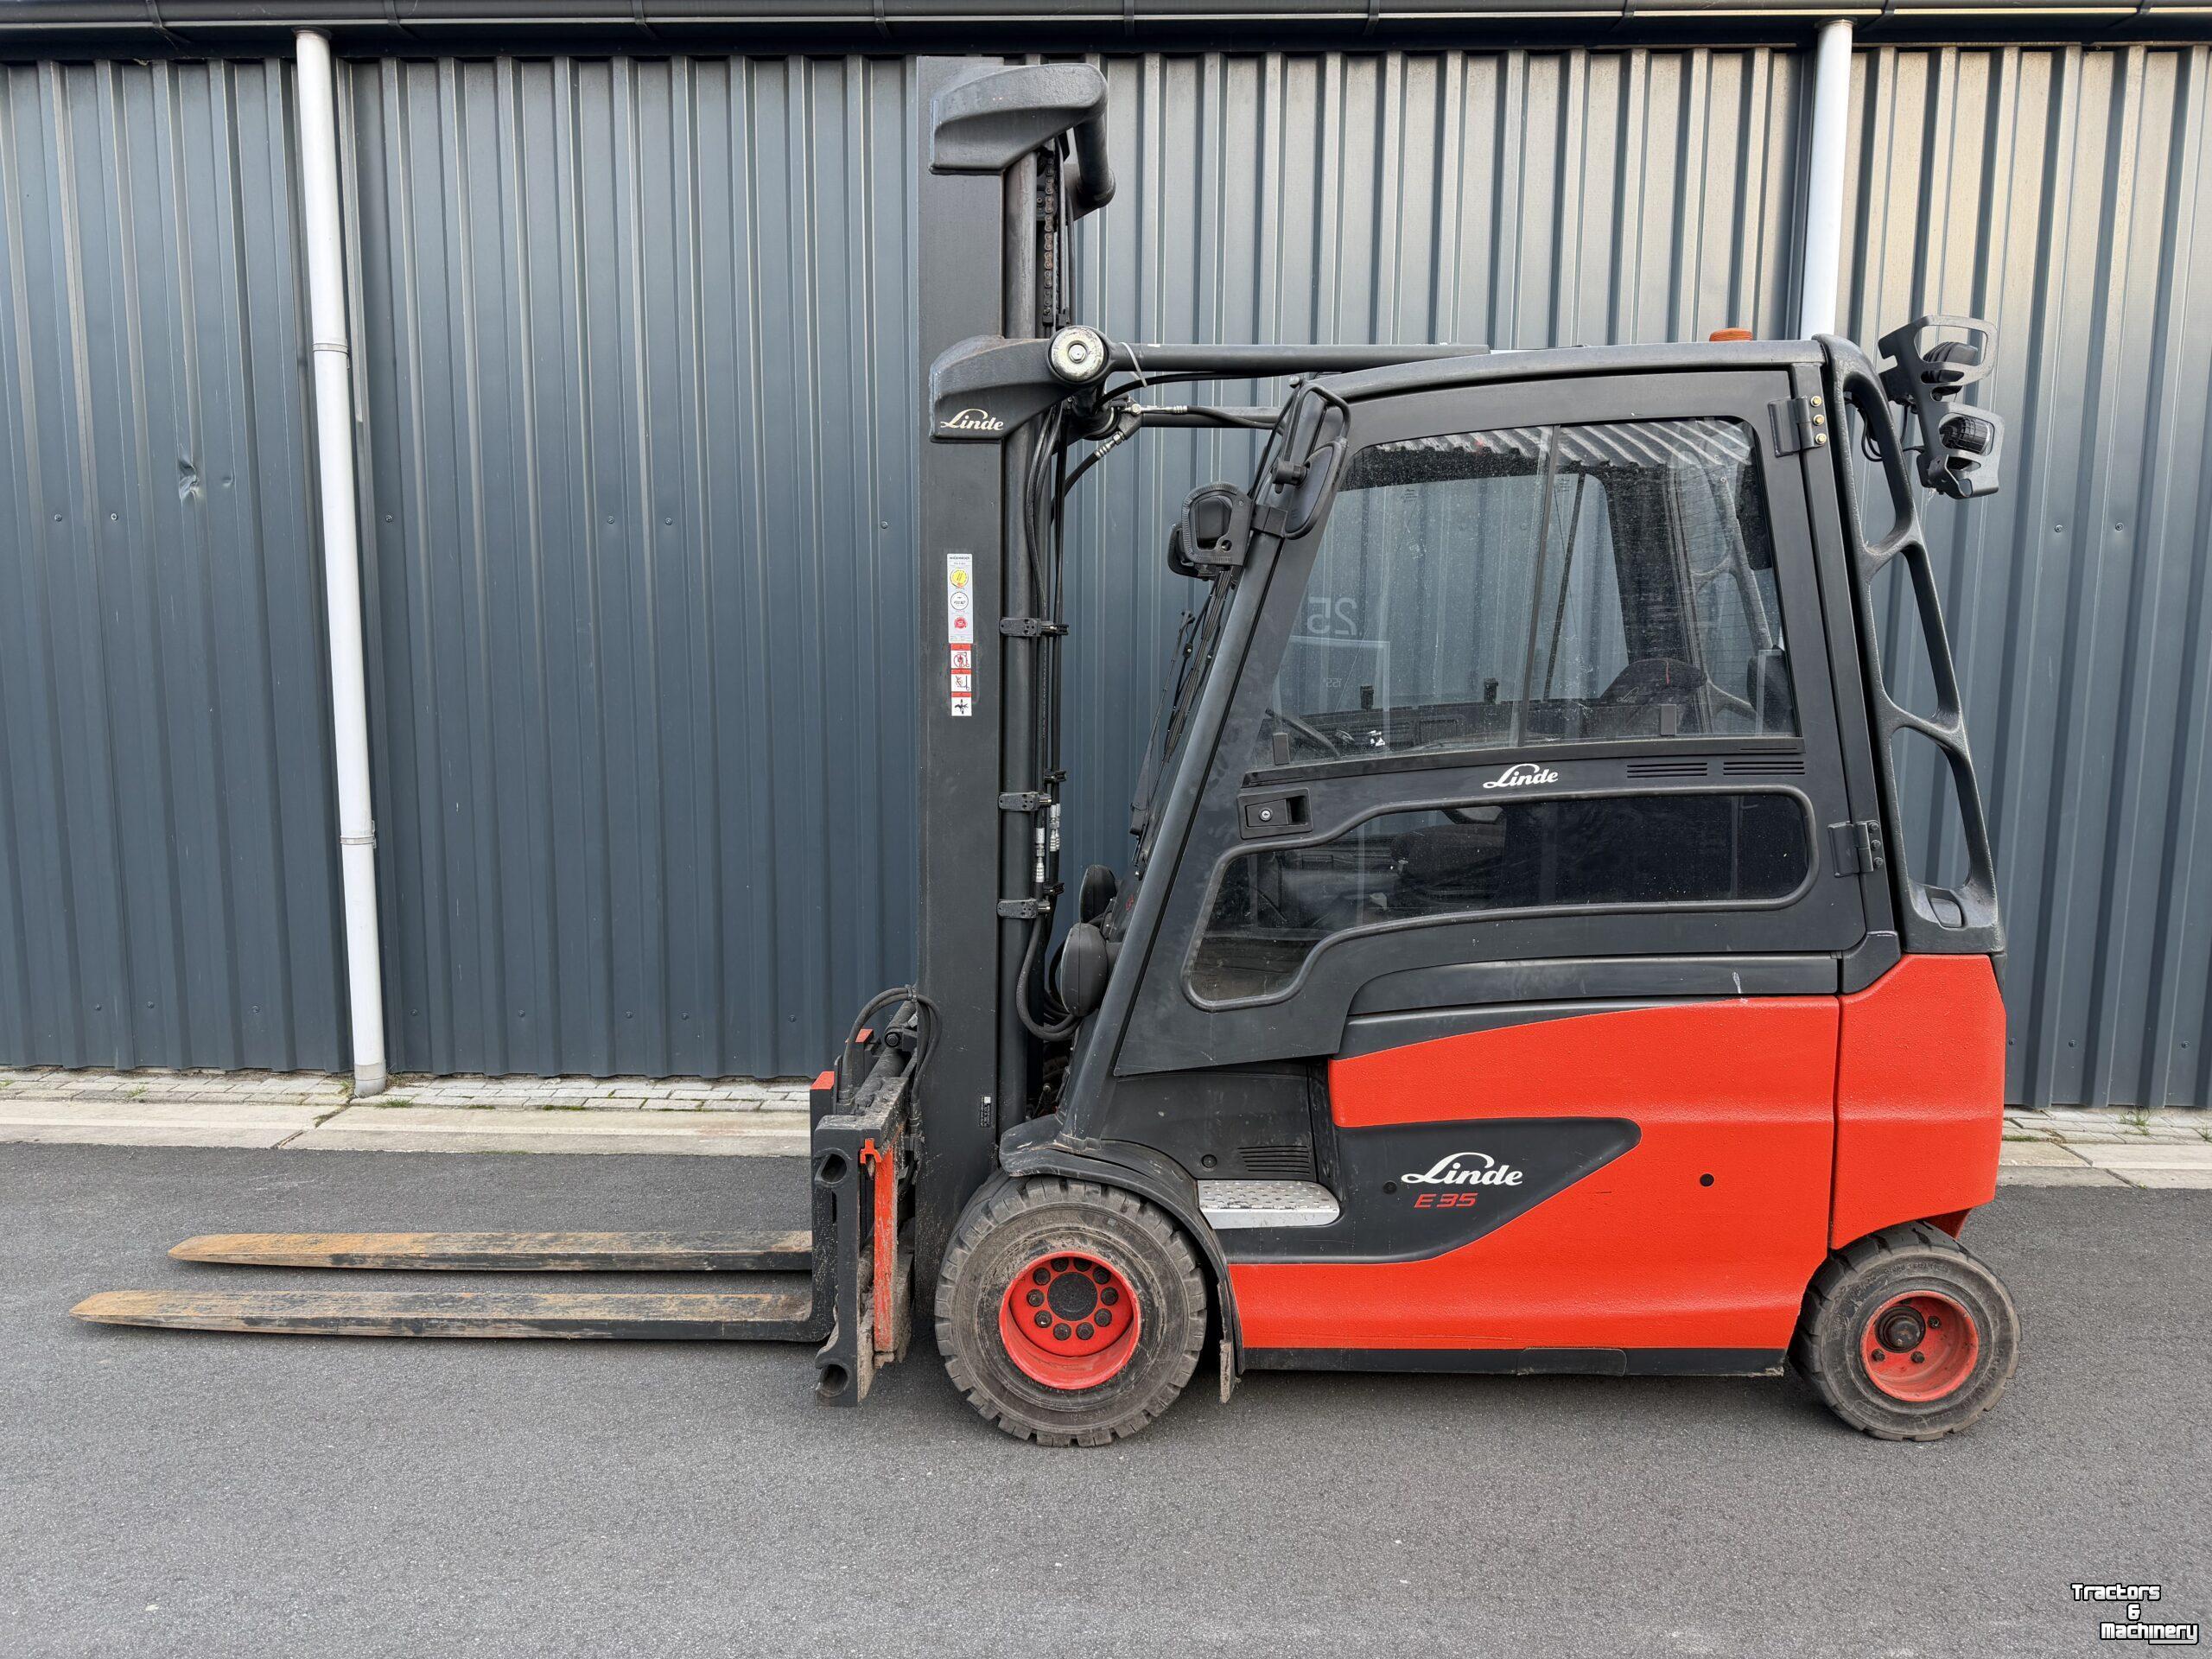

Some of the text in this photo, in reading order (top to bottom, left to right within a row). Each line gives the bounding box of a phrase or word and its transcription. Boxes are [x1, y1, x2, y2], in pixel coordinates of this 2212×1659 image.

[940, 408, 1004, 430] Linde
[1483, 763, 1559, 789] Linde
[1401, 1152, 1523, 1186] Linde
